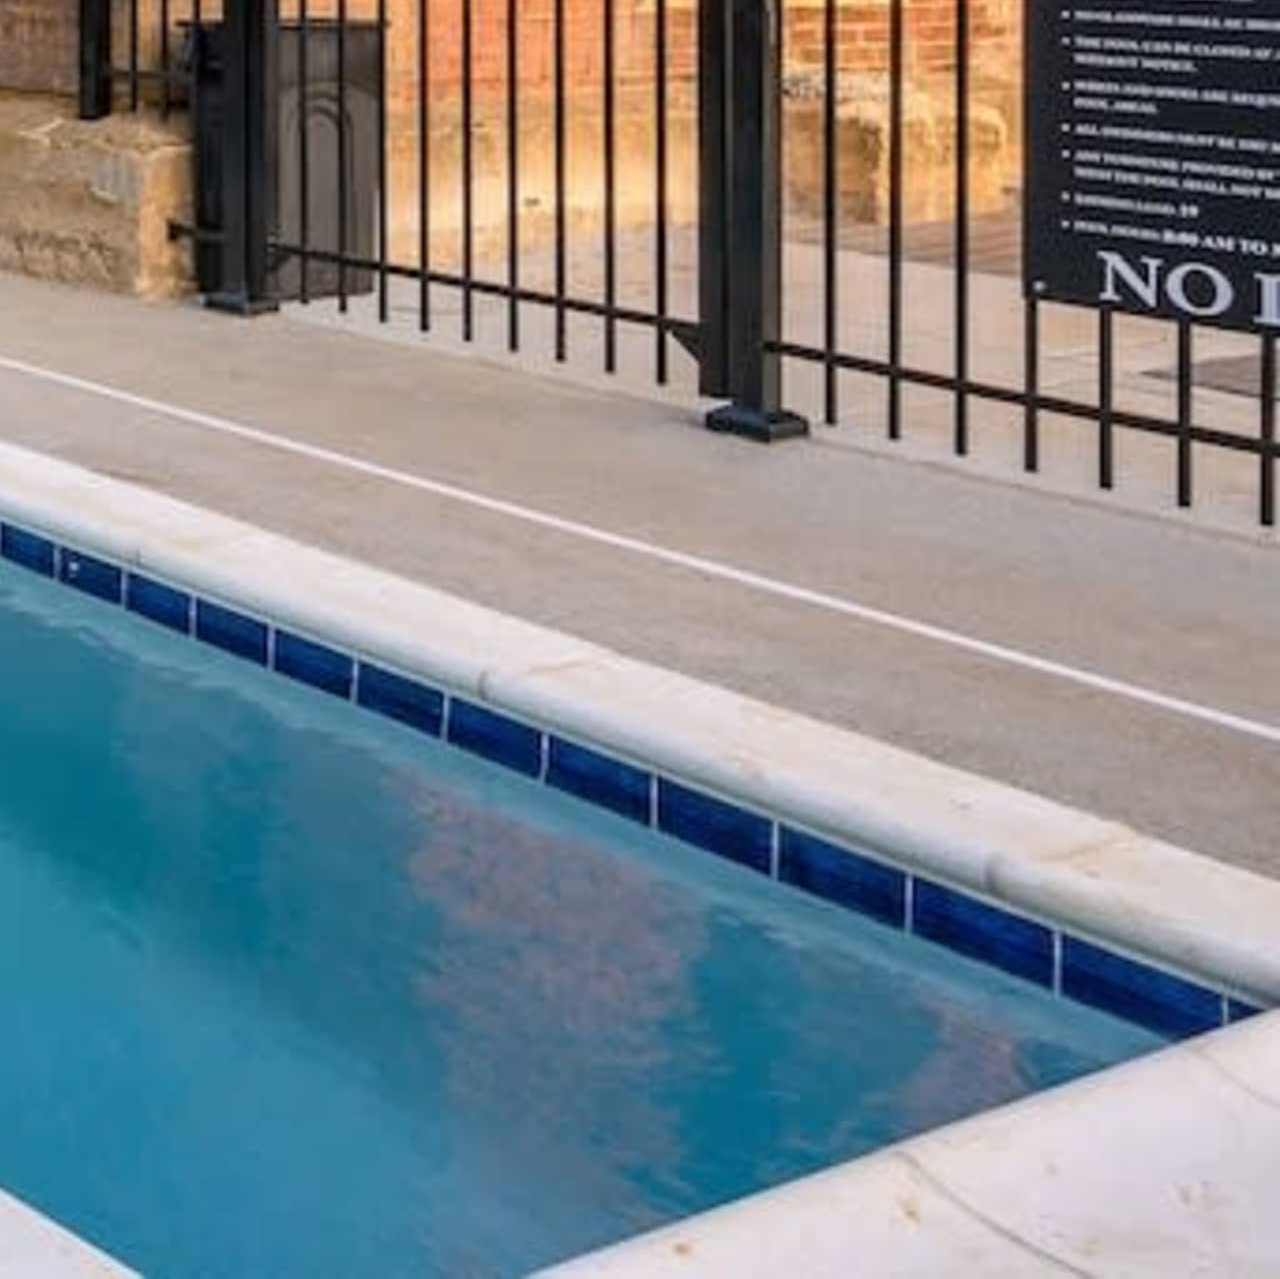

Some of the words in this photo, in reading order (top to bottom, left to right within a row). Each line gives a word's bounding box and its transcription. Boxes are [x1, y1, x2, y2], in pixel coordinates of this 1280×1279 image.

[1202, 236, 1235, 251] AM
[1239, 239, 1268, 255] TO
[1097, 250, 1233, 317] NO
